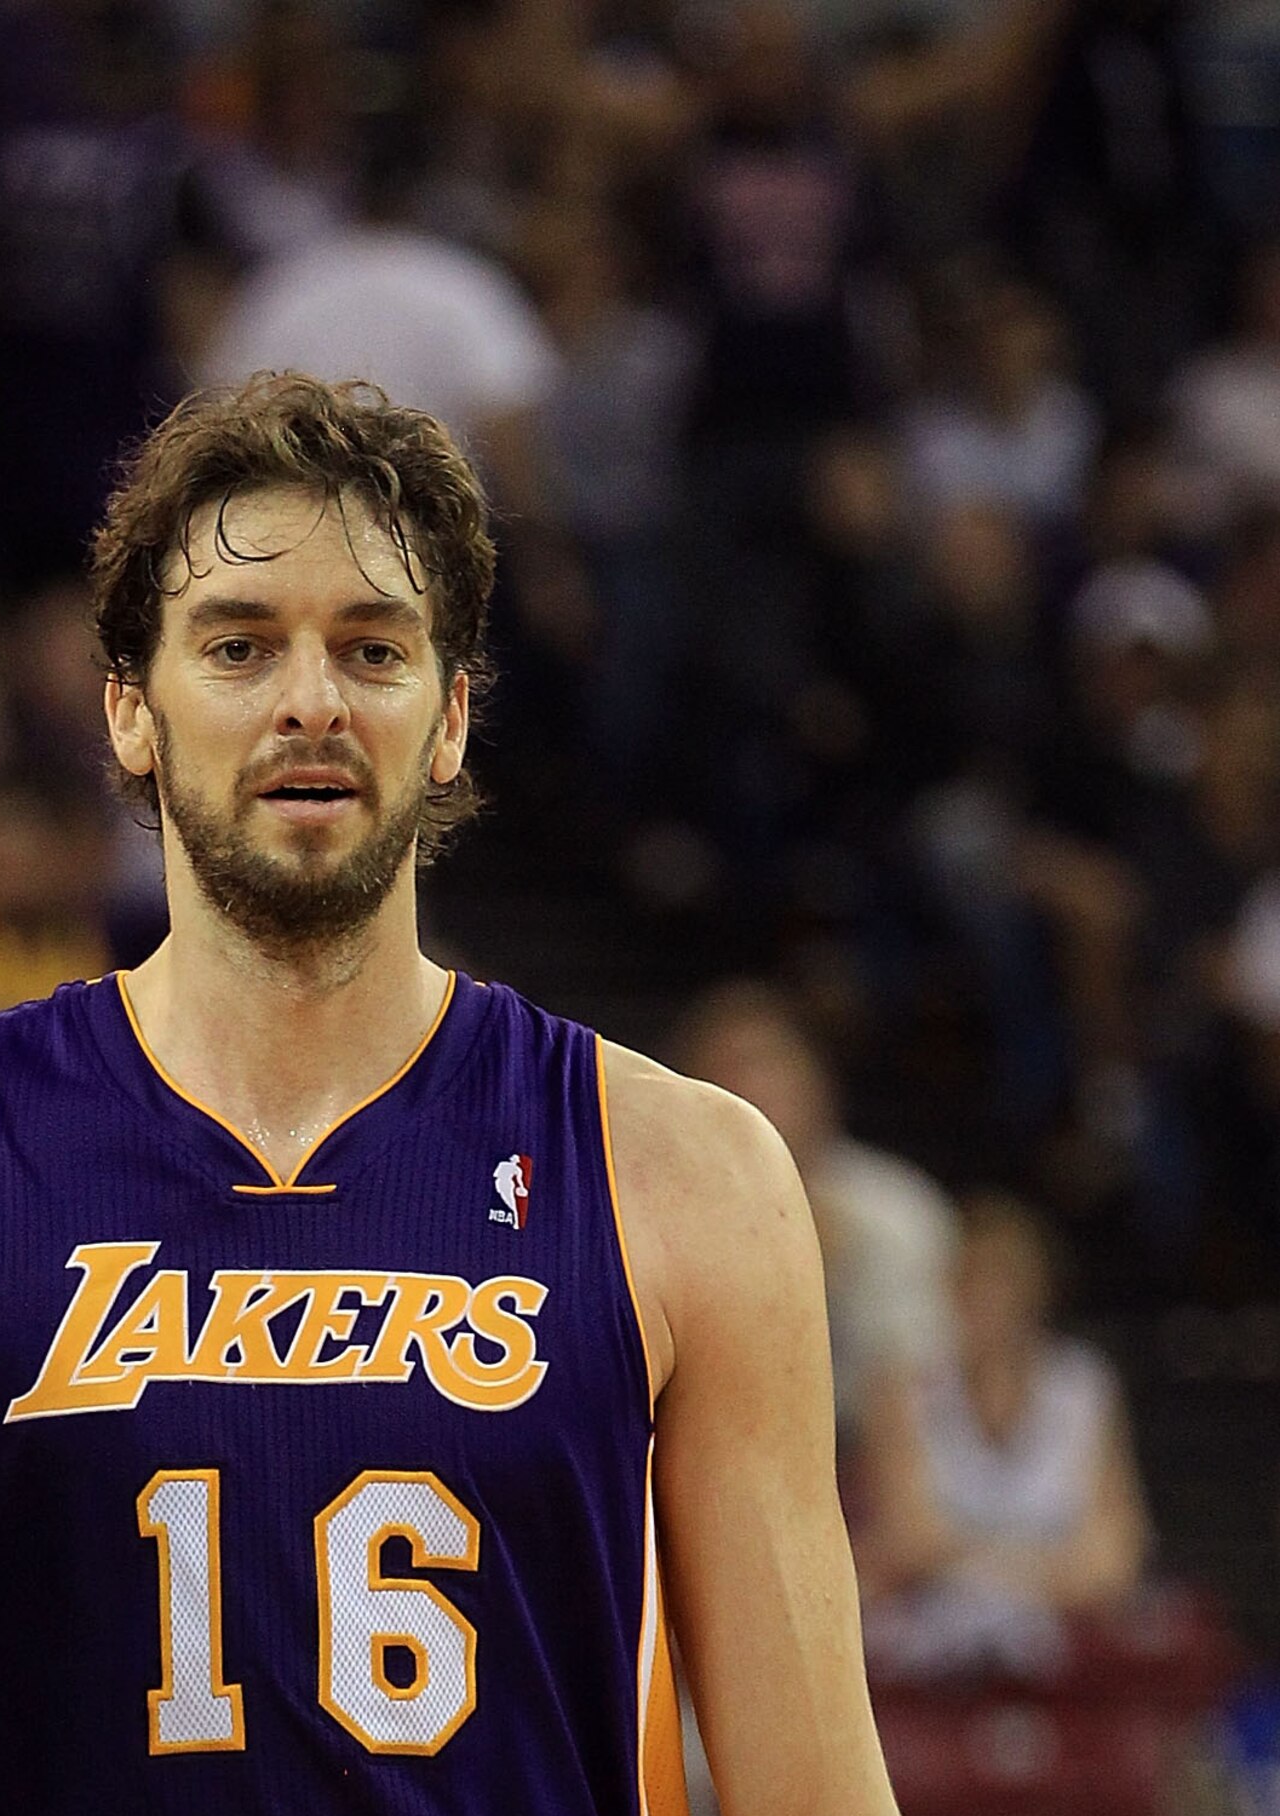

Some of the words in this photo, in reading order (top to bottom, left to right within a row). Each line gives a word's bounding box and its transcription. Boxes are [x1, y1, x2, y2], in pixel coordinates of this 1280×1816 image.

[488, 1208, 513, 1225] NBA
[3, 1240, 550, 1424] LAKERS
[136, 1468, 481, 1757] 16
